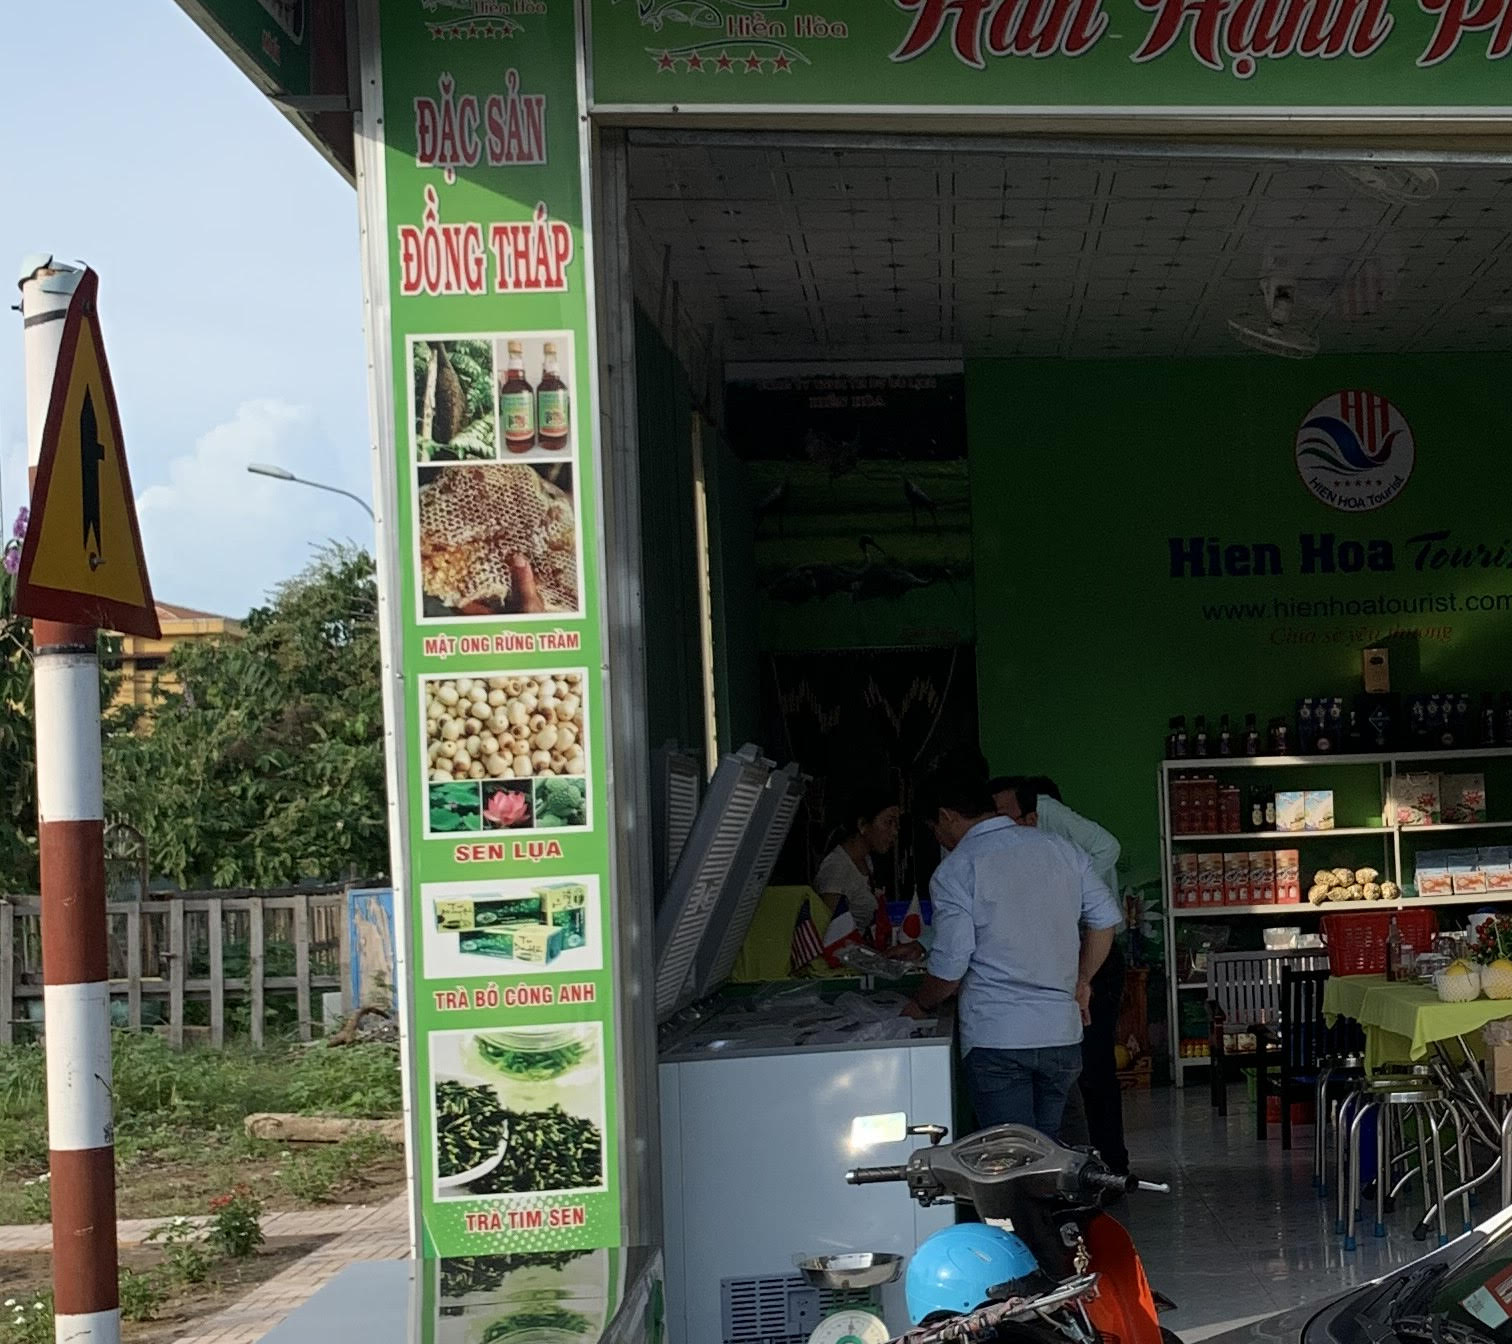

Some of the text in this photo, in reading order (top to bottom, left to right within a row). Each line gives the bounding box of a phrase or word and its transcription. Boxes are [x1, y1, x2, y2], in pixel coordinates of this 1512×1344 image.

[726, 11, 849, 38] Hiền Hòa
[414, 68, 547, 184] ĐẶC SẢN
[397, 184, 574, 296] ĐỒNG THÁP
[1168, 536, 1285, 579] Hien
[1299, 532, 1396, 576] Hoa
[424, 629, 581, 659] MẬT ONG RỪNG TRÀM
[455, 840, 562, 863] SEN LỤA
[433, 985, 470, 1011] TRÀ
[504, 983, 553, 1007] CÔNG
[559, 982, 597, 1004] ANH
[464, 1205, 586, 1233] TRÀ TIM SEN
